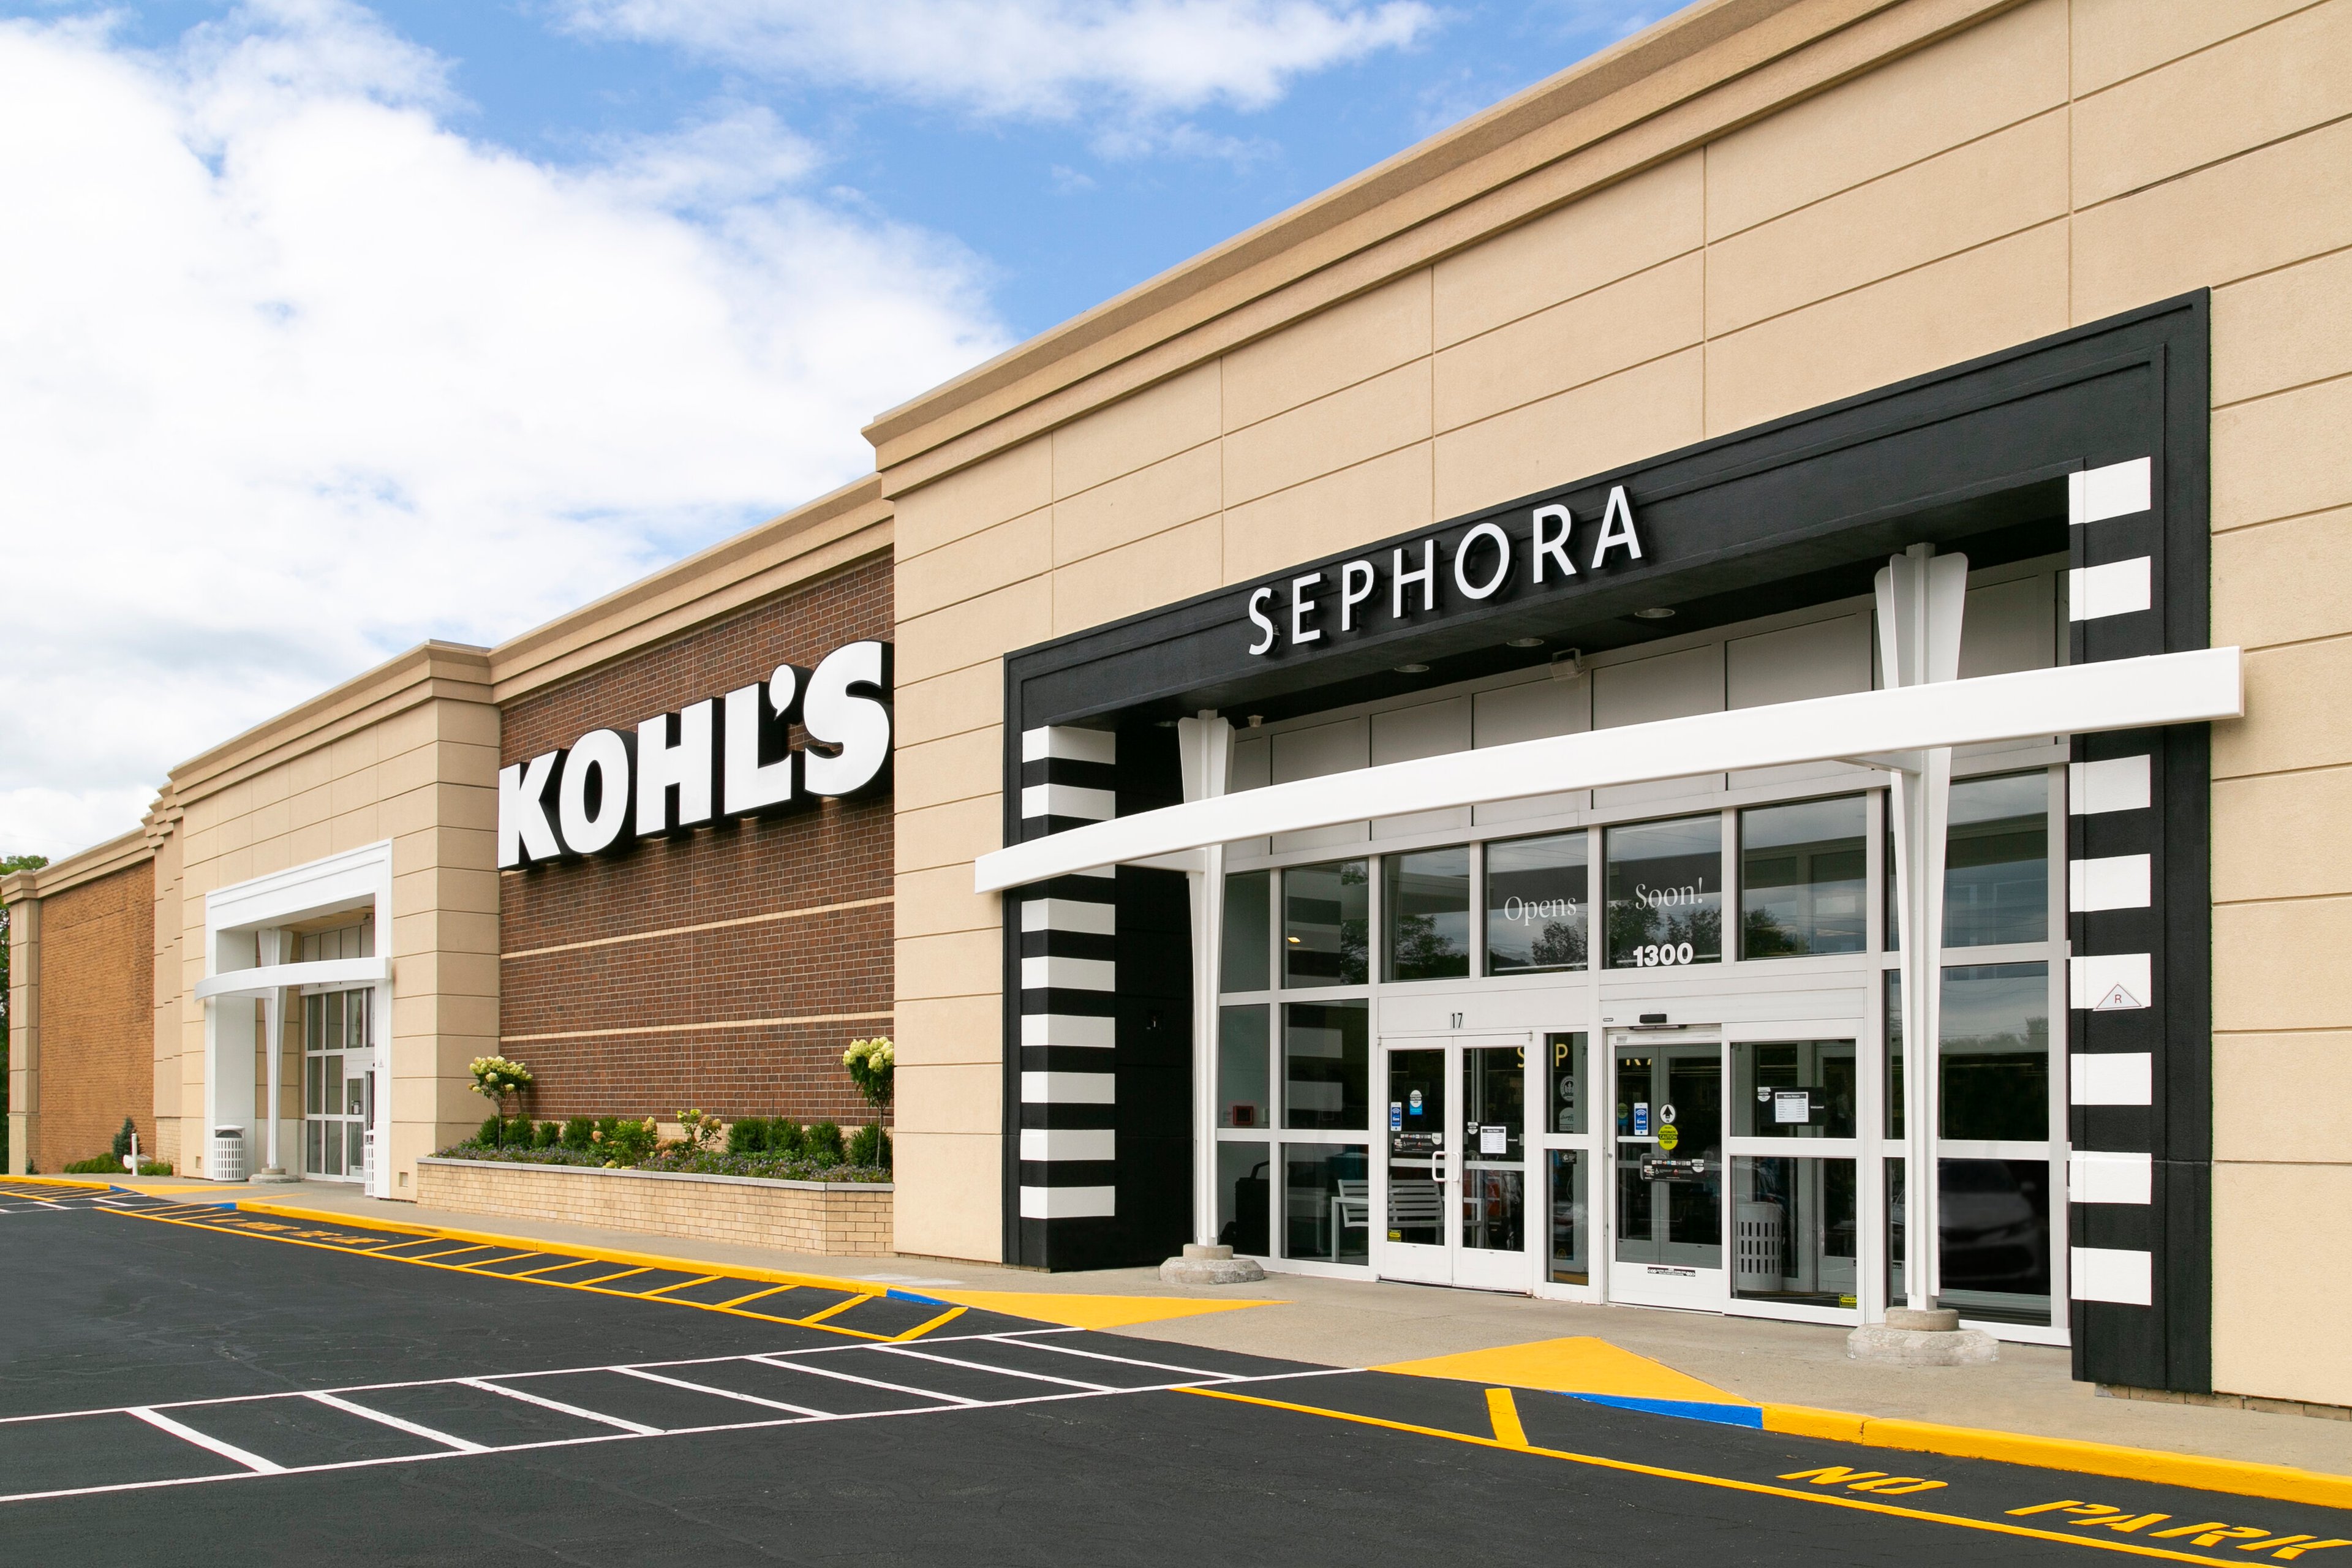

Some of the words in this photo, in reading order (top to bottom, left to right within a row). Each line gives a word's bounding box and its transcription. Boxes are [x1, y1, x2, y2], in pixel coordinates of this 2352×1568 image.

[1248, 485, 1643, 656] SEPHORA
[497, 640, 892, 870] KOHL'S
[1504, 895, 1577, 926] Opens
[1635, 876, 1703, 910] Soon!
[1633, 942, 1694, 967] 1300
[2114, 994, 2122, 1004] R
[1451, 1012, 1463, 1029] 17
[1776, 1466, 1948, 1494] NO
